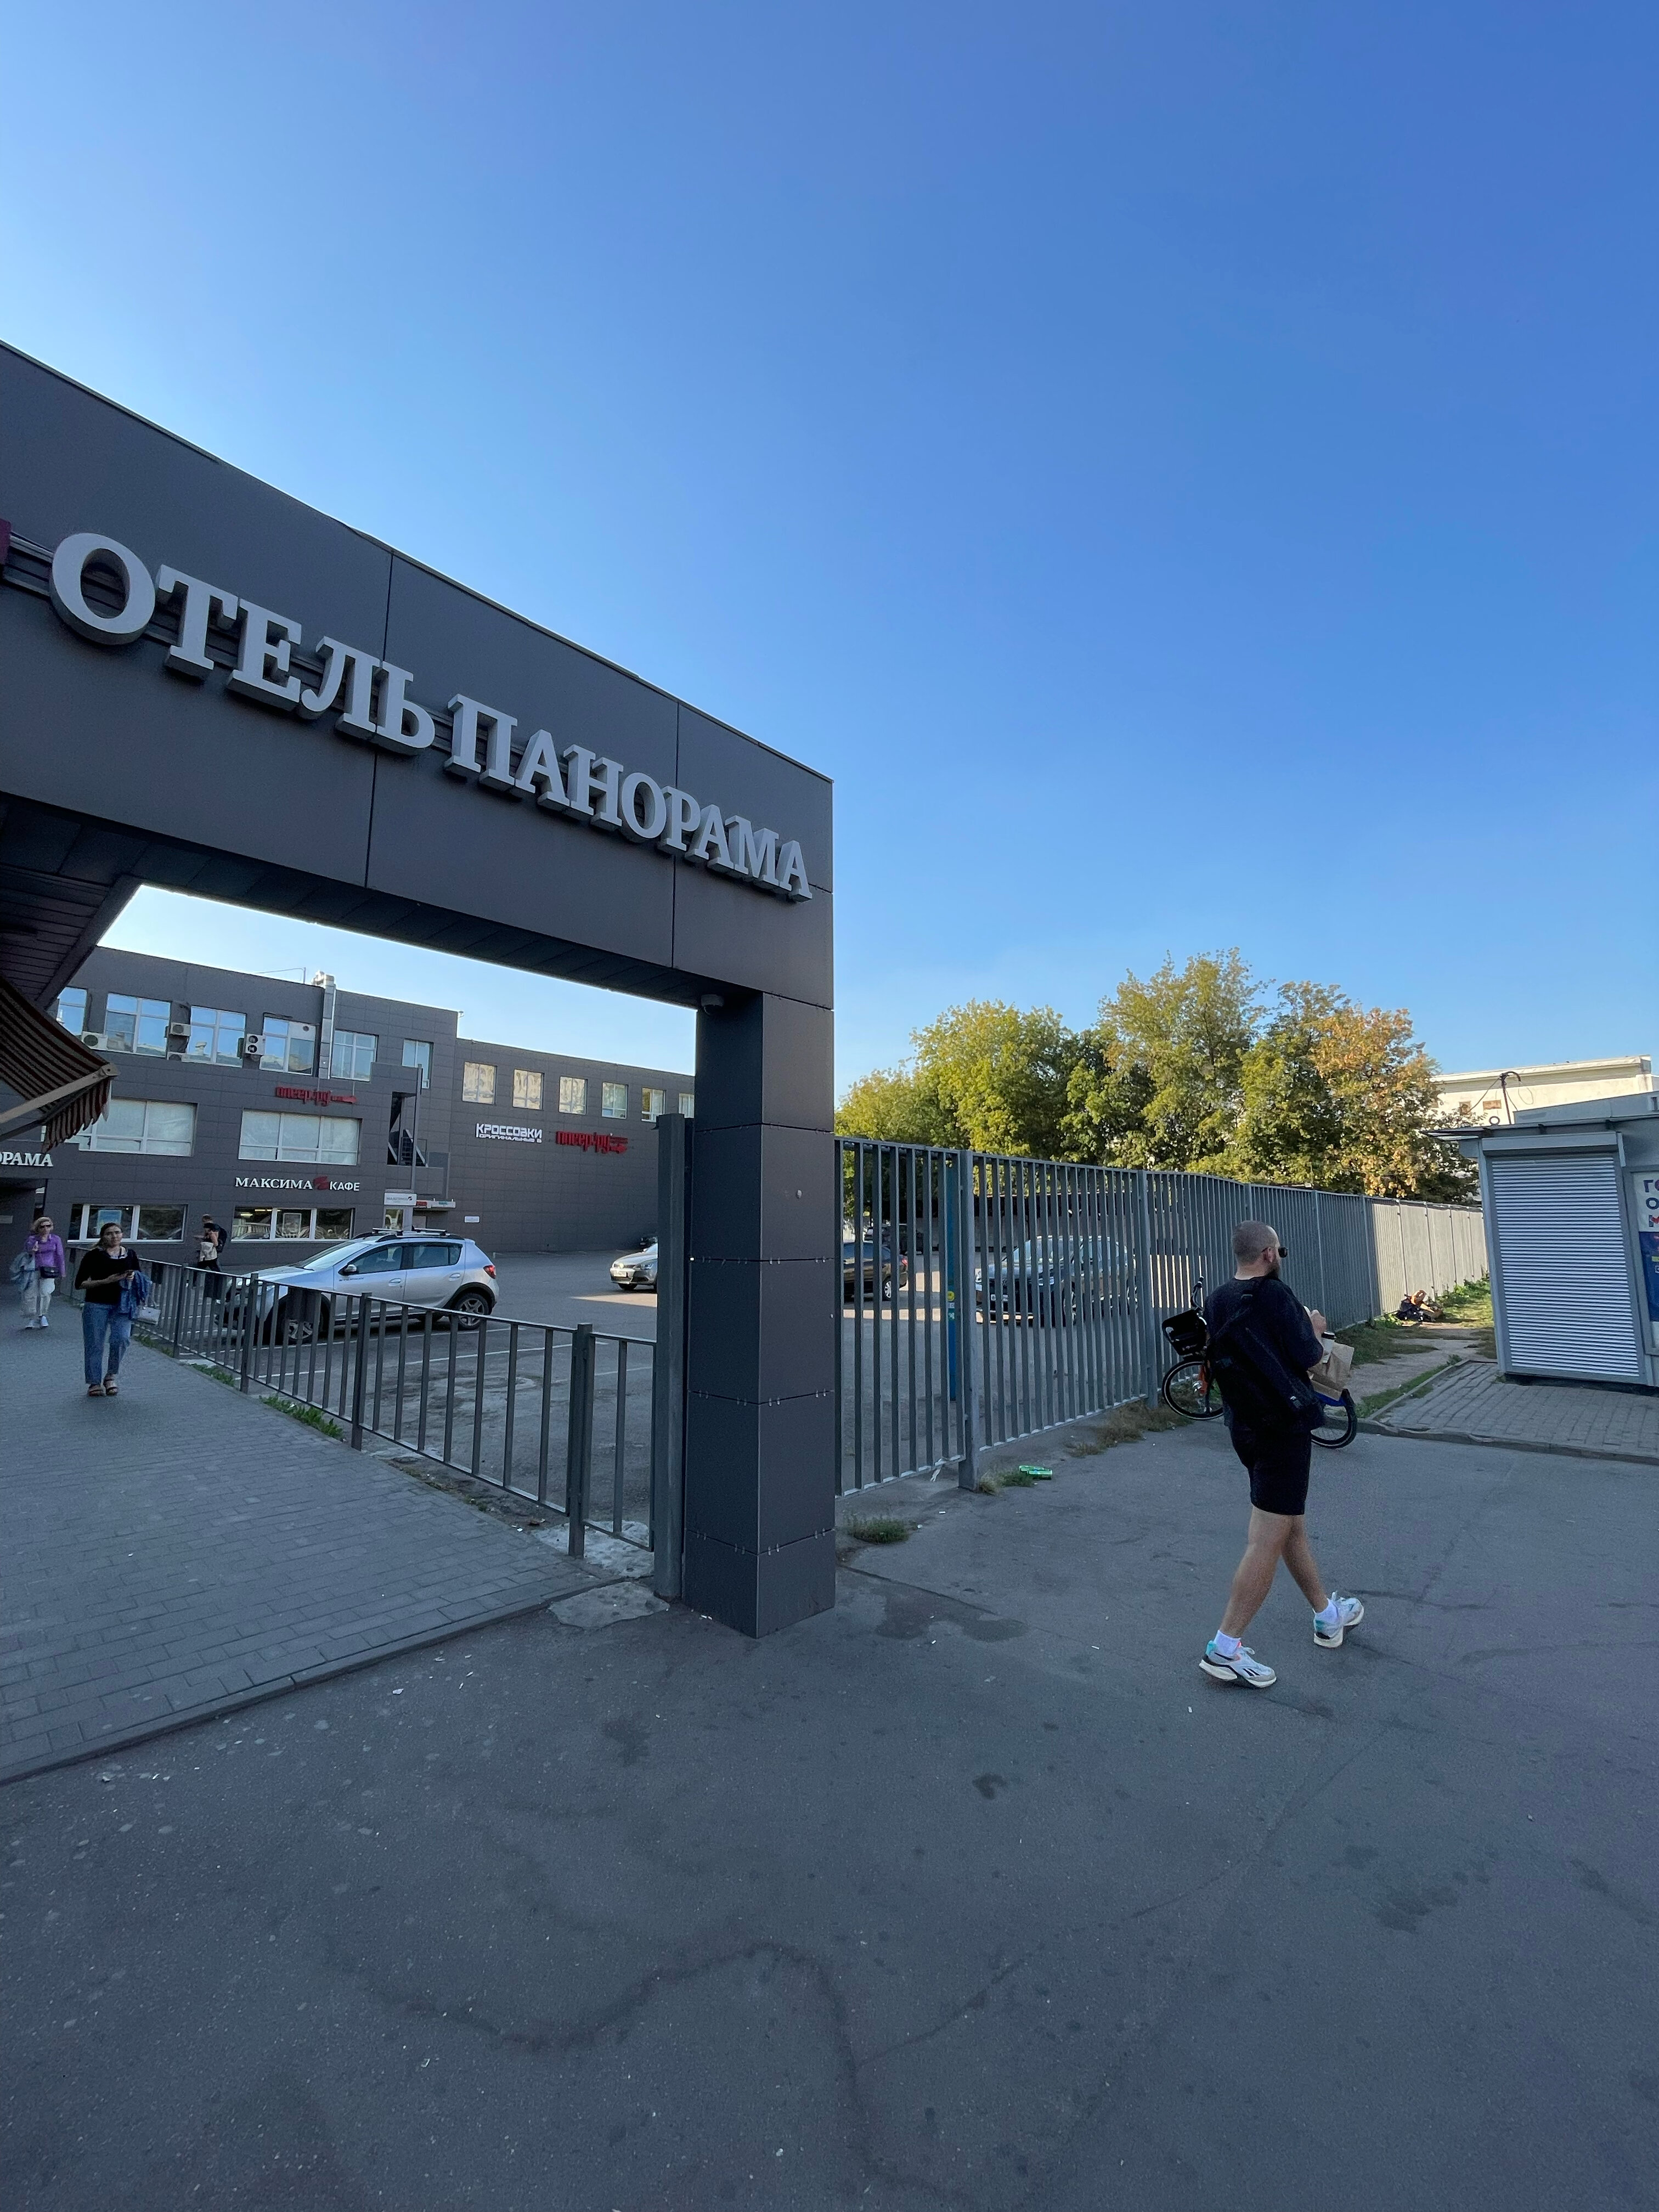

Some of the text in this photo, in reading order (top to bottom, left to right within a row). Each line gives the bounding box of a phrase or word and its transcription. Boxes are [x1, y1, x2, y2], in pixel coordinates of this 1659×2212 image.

[51, 533, 812, 902] ОТЕЛЬ ПАНОРАМА
[0, 1152, 53, 1167] РАМА
[235, 1177, 360, 1191] МАКСИМА КАФЕ
